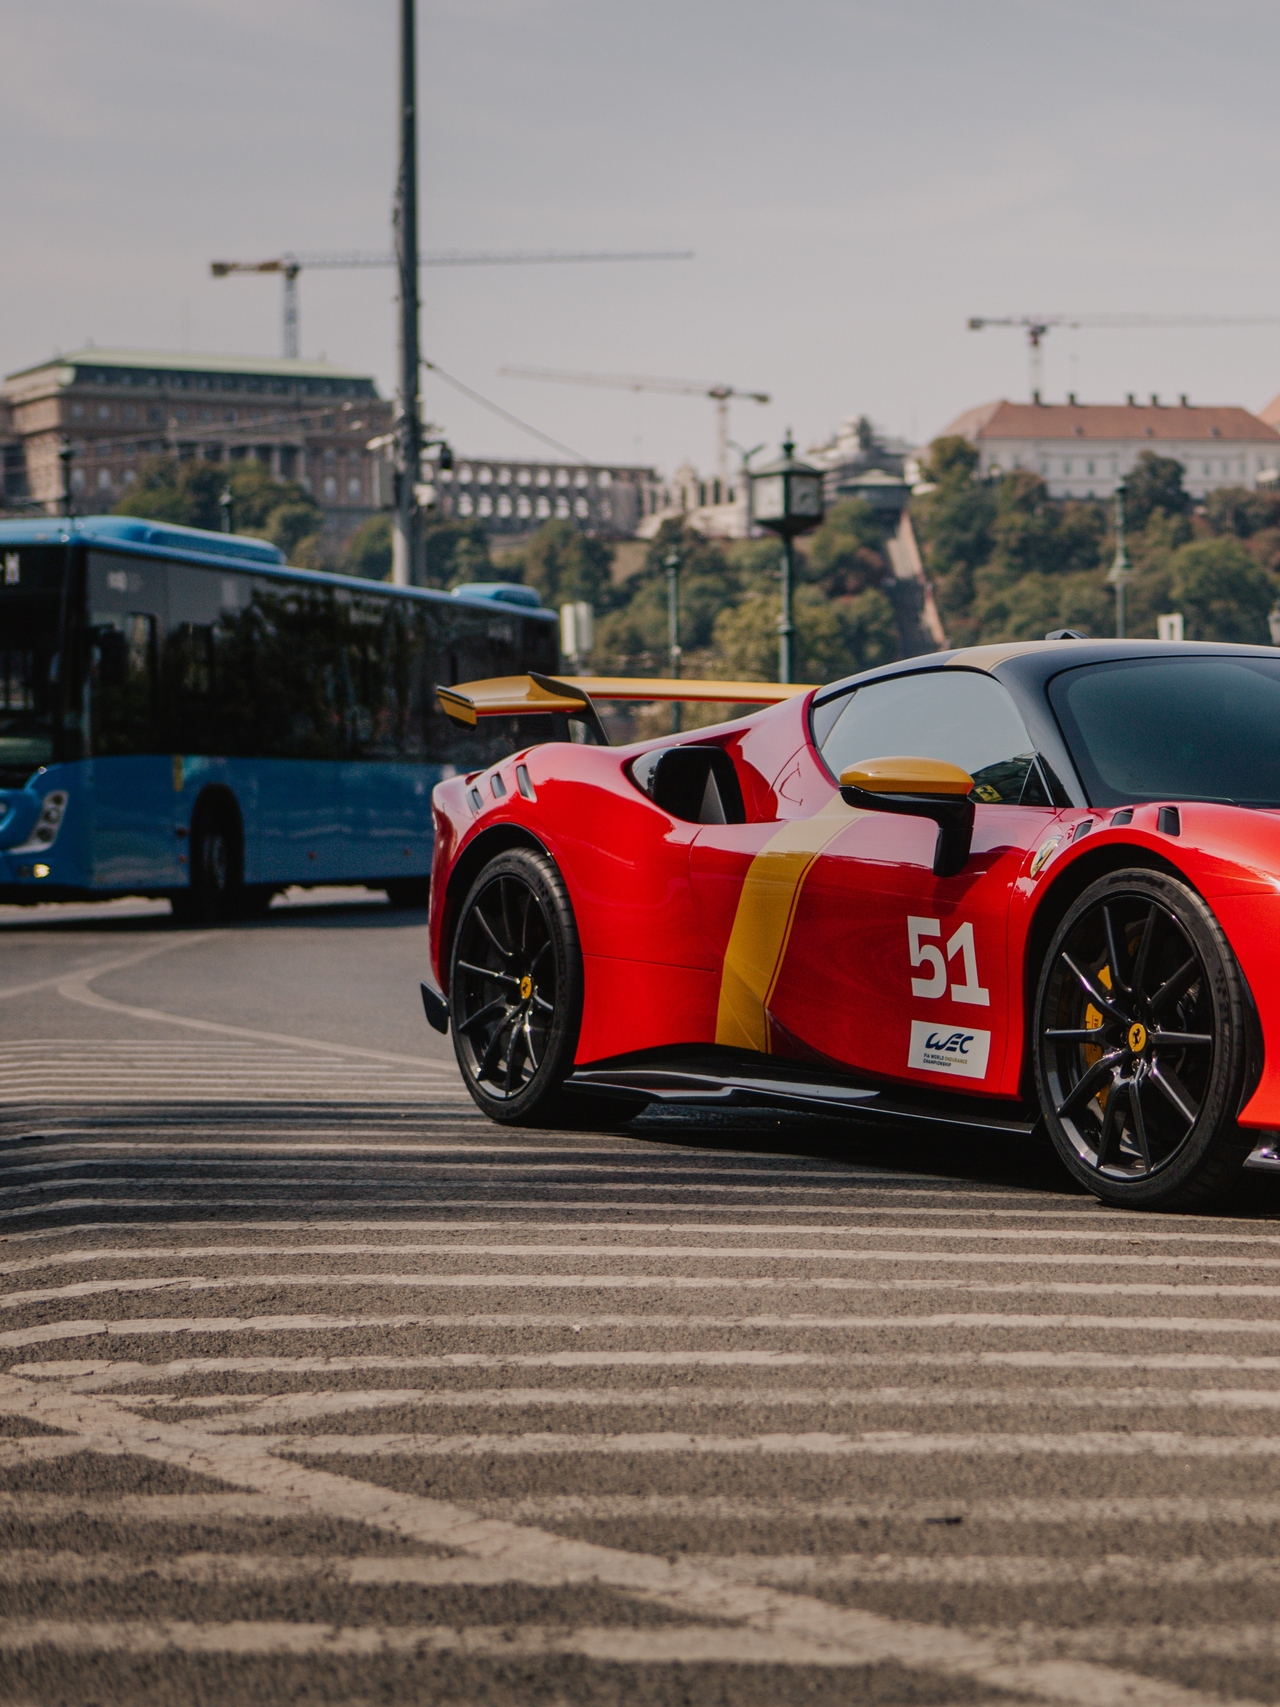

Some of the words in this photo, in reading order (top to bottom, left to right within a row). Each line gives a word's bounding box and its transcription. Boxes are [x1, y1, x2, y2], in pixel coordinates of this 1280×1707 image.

[907, 915, 990, 1006] 51
[925, 1032, 974, 1054] WEC
[923, 1059, 951, 1067] CHAMPIONSHIP
[945, 1056, 968, 1064] ENDURANCE
